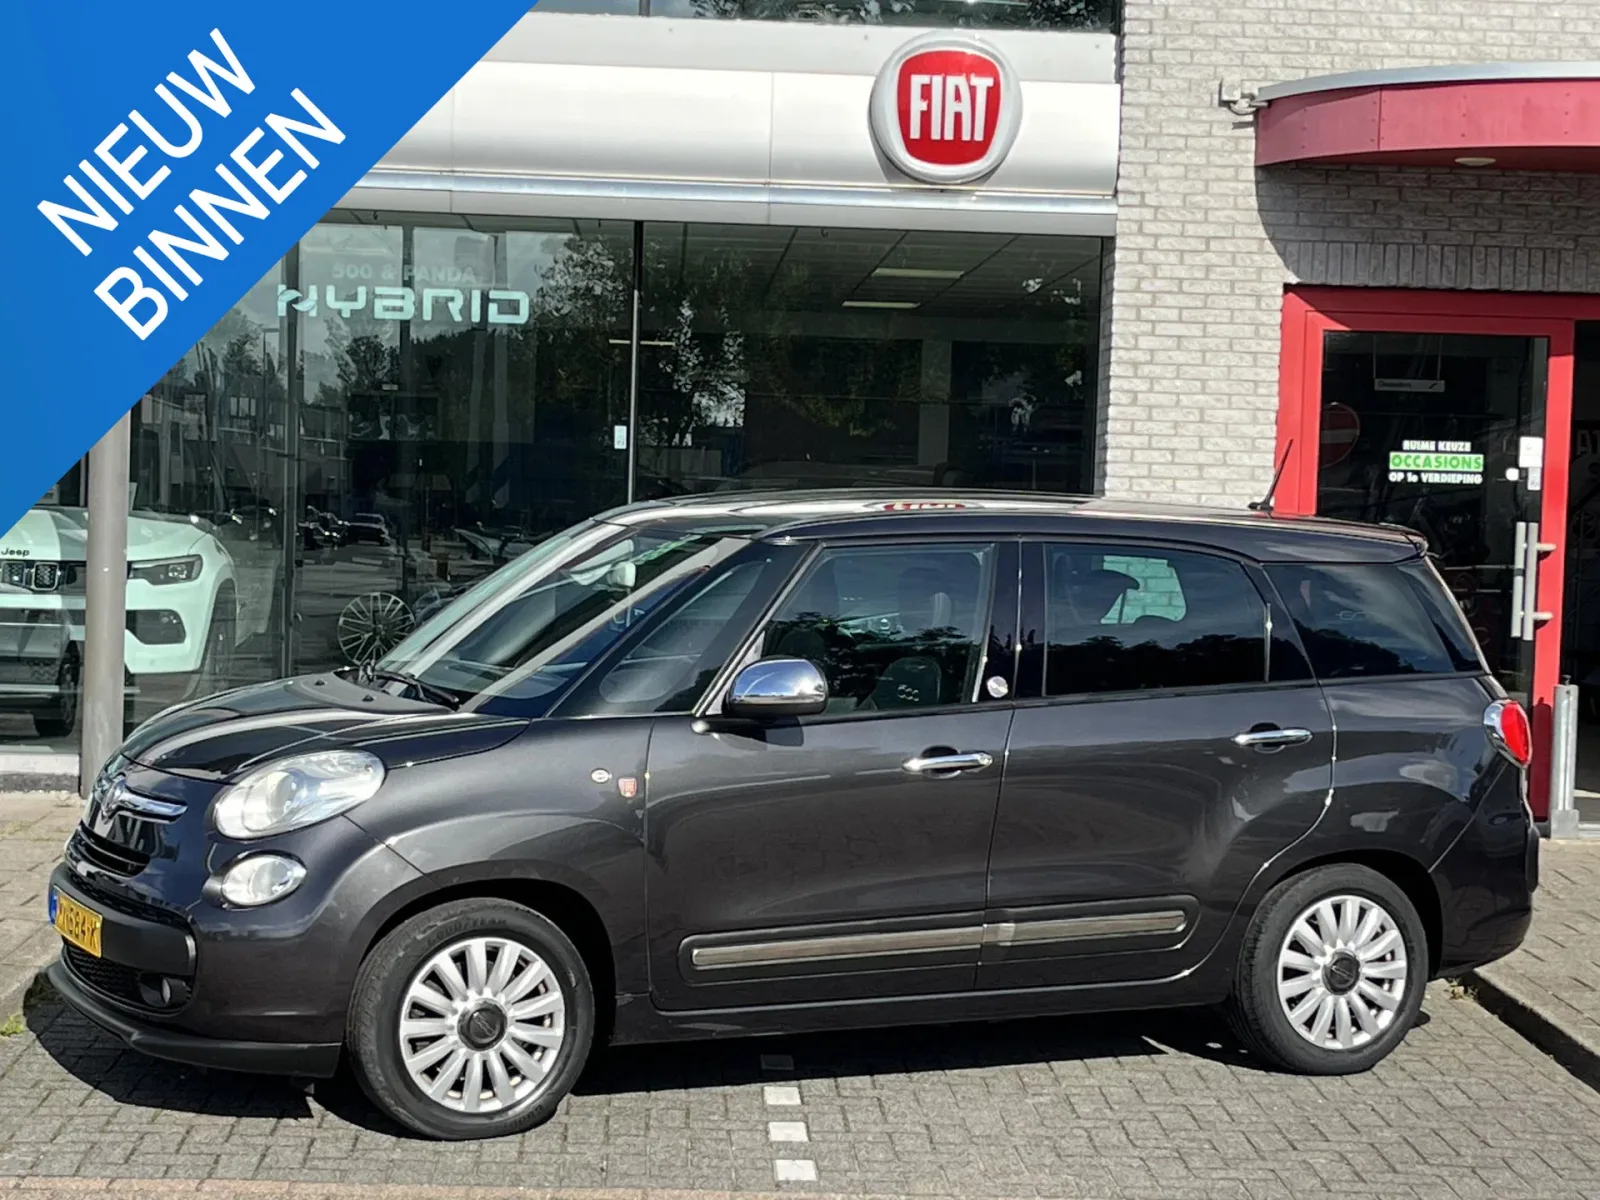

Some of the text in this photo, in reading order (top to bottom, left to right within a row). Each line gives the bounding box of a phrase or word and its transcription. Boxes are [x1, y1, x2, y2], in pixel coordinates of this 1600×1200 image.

[909, 73, 994, 141] FIAT
[332, 262, 372, 280] 500
[403, 264, 477, 283] PANDA
[276, 284, 530, 325] HYBRID
[1402, 440, 1472, 452] RUIME KEUZE
[1391, 454, 1482, 469] OCCASIONS
[1388, 471, 1405, 482] OP
[1420, 473, 1483, 485] VERDIEPING
[1, 547, 30, 557] Jeep
